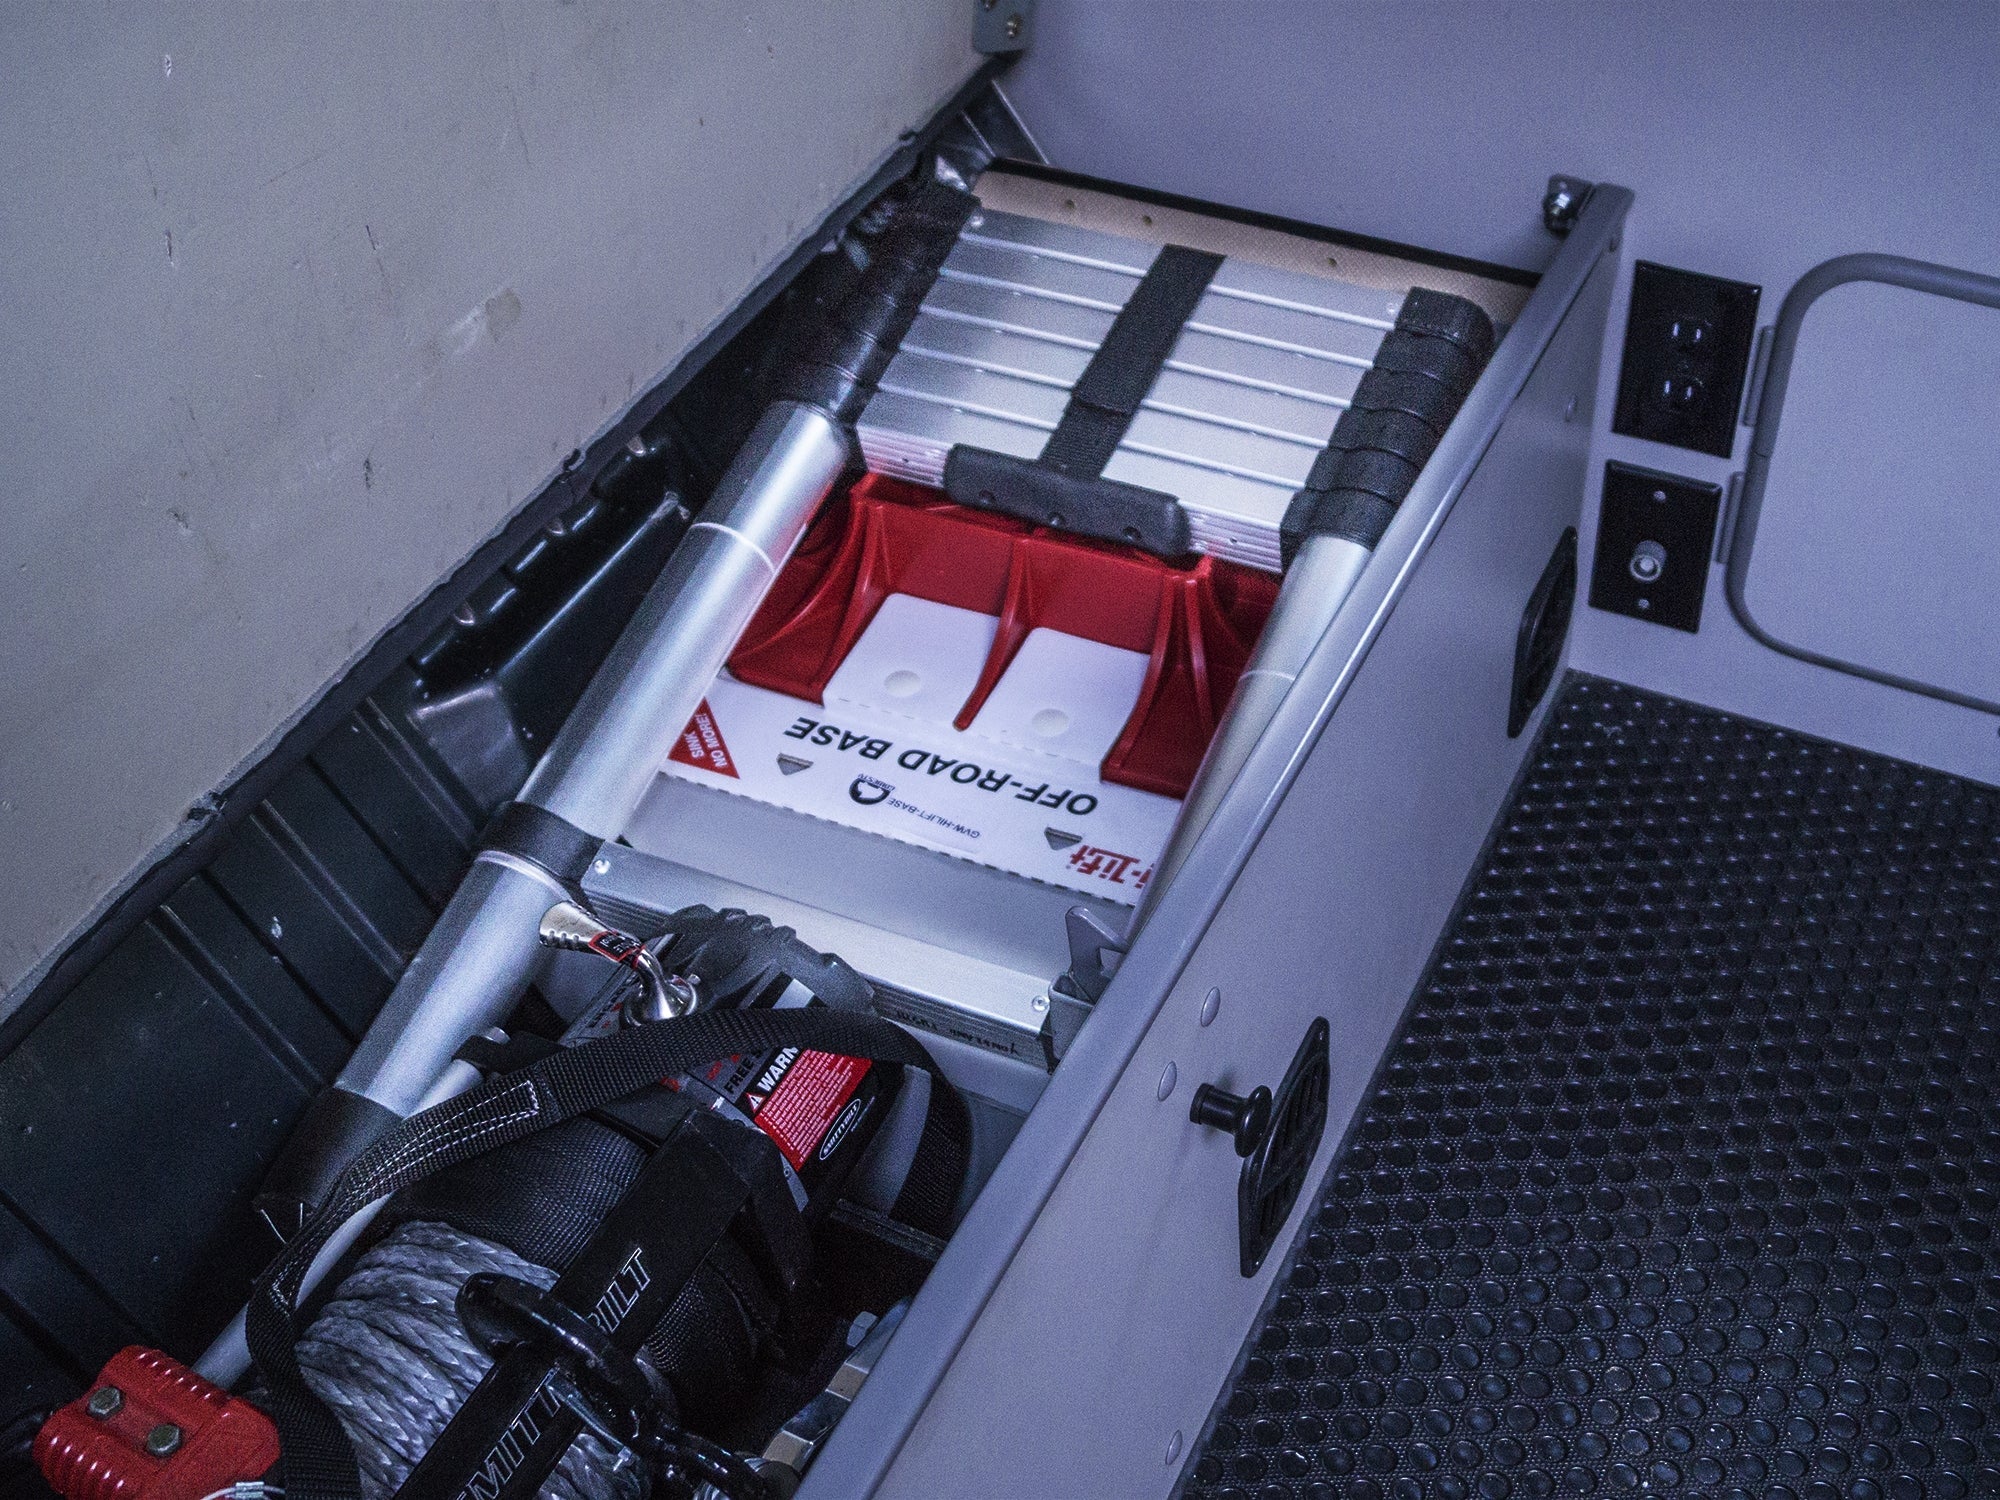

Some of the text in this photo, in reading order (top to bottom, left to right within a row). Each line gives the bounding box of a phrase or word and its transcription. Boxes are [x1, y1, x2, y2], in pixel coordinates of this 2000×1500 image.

[683, 731, 704, 759] SINK
[695, 713, 728, 768] NO MORE!
[782, 717, 1099, 816] OFF-ROAD BASE
[724, 1057, 756, 1094] FREE
